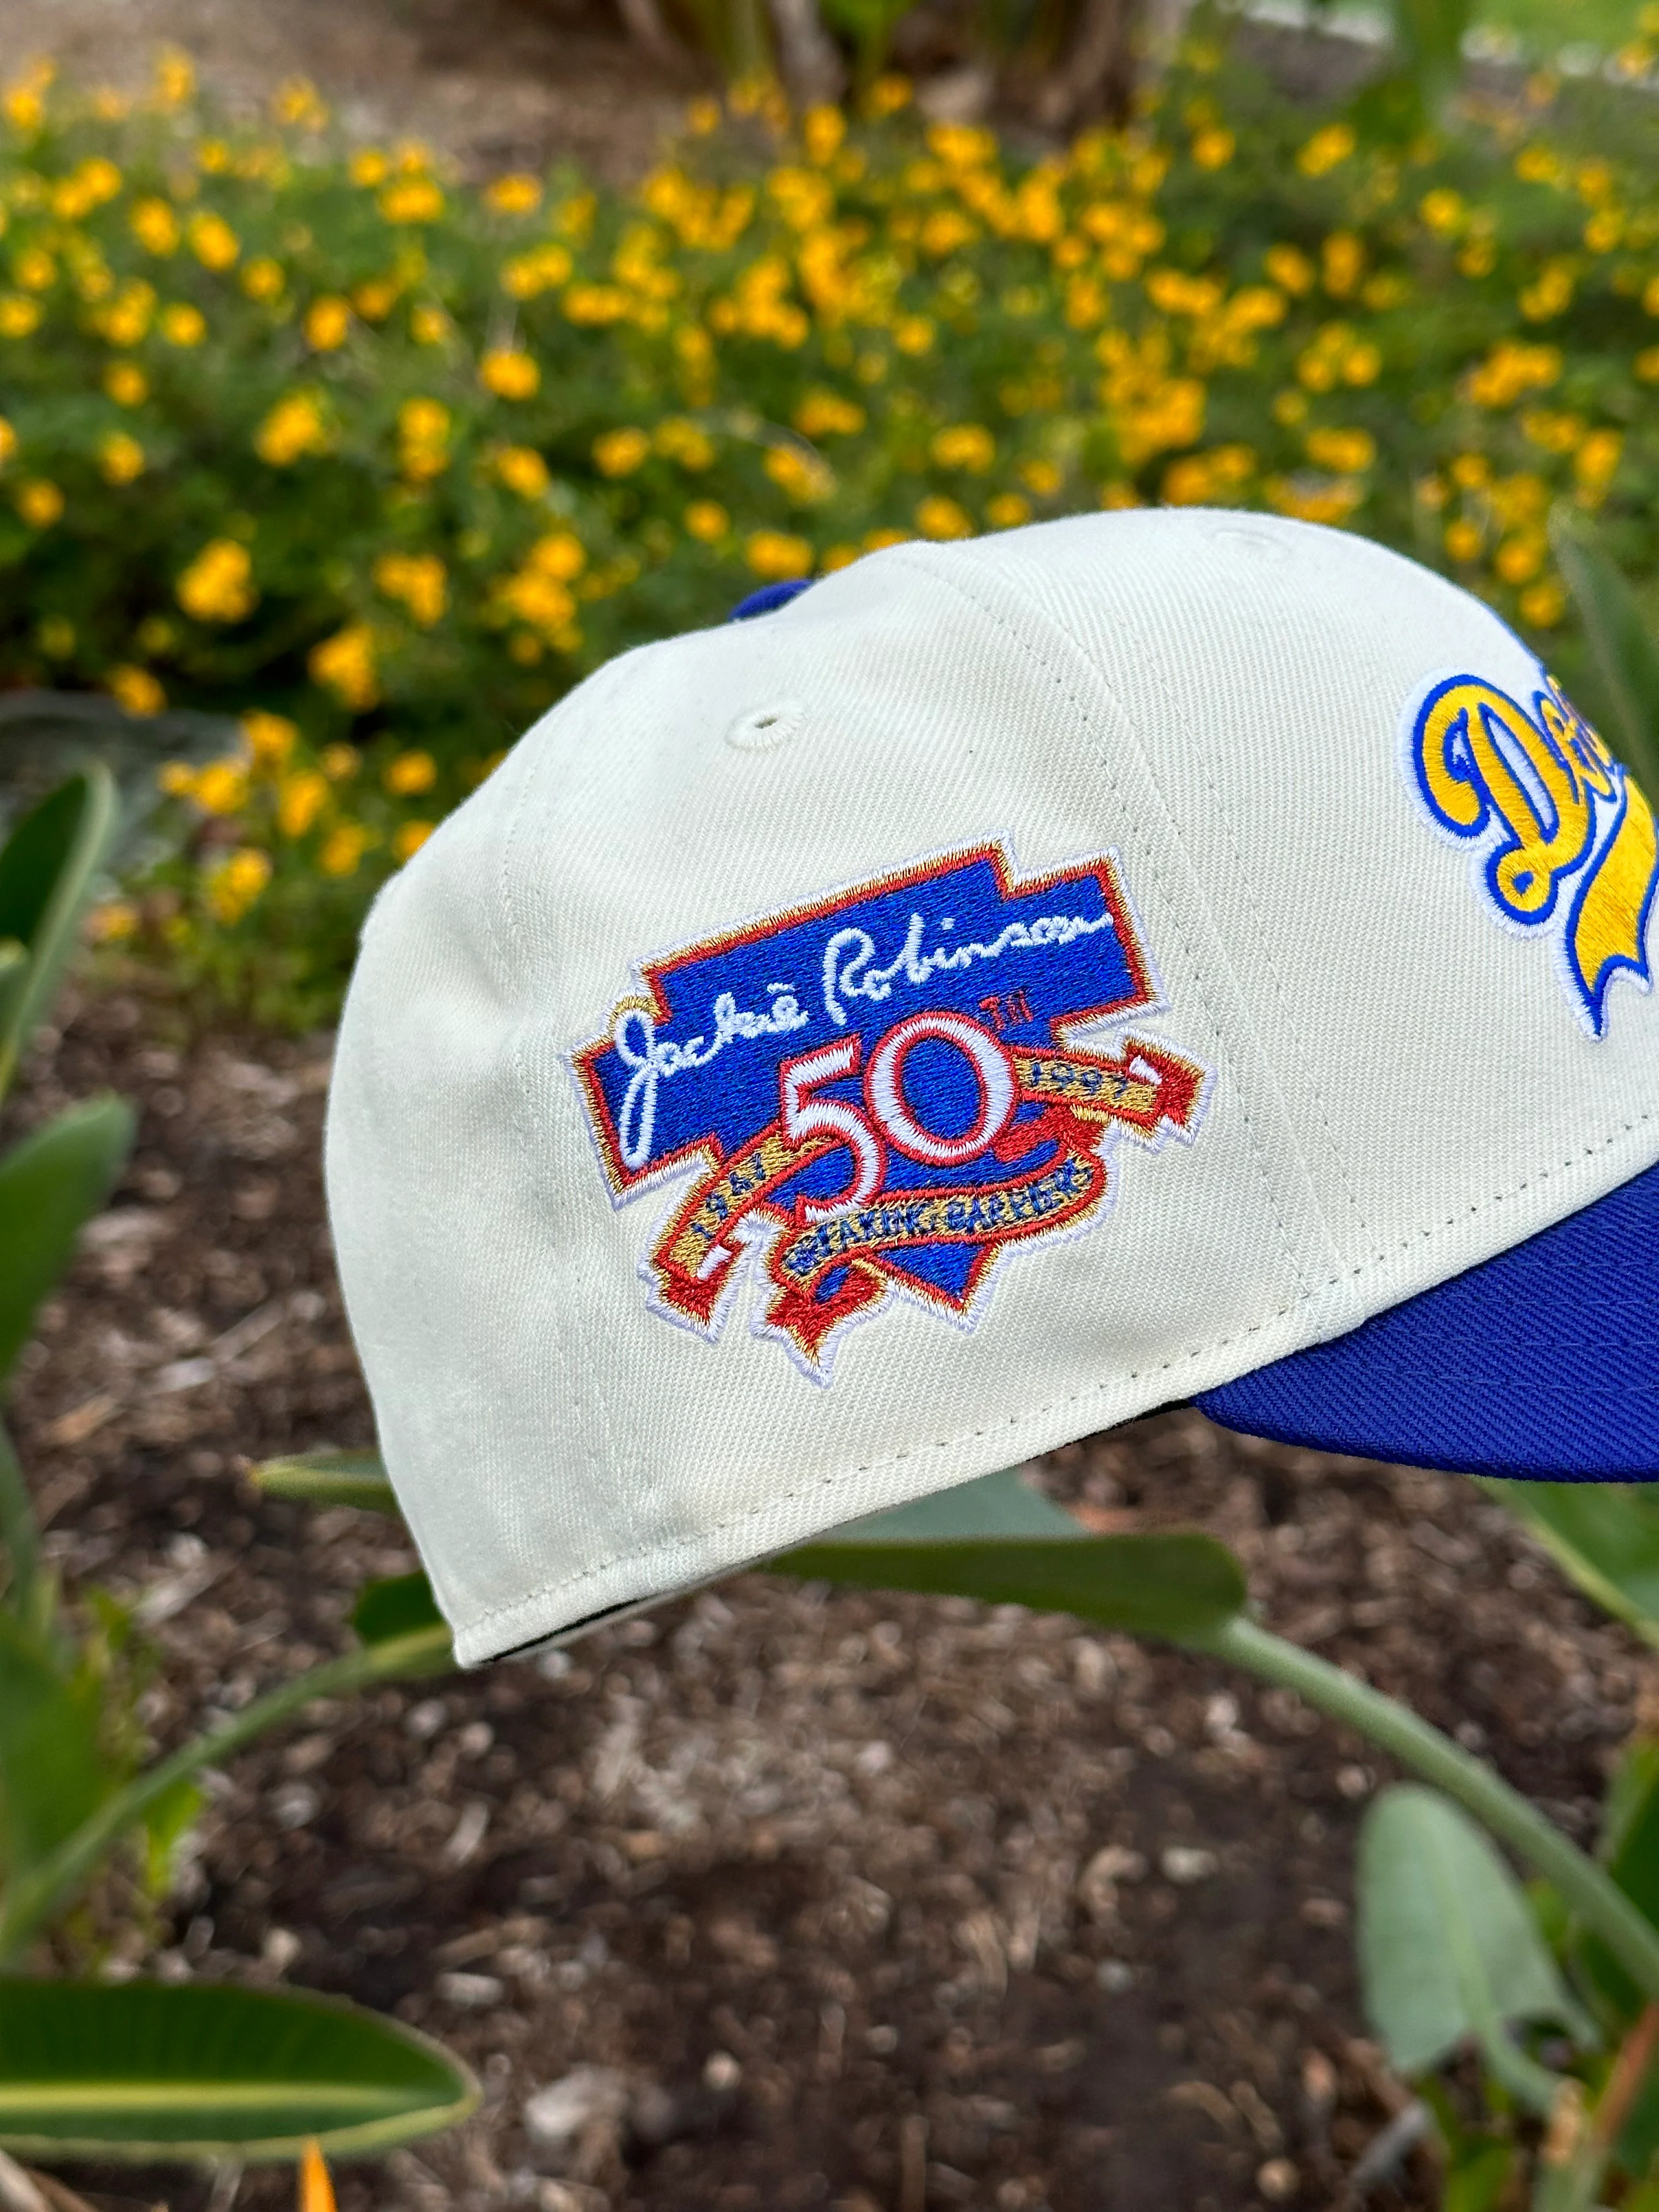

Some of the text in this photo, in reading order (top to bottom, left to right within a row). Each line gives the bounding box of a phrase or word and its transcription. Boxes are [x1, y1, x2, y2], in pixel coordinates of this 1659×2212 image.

[614, 912, 1114, 1167] Jackie Robinson
[781, 1011, 1018, 1222] 50
